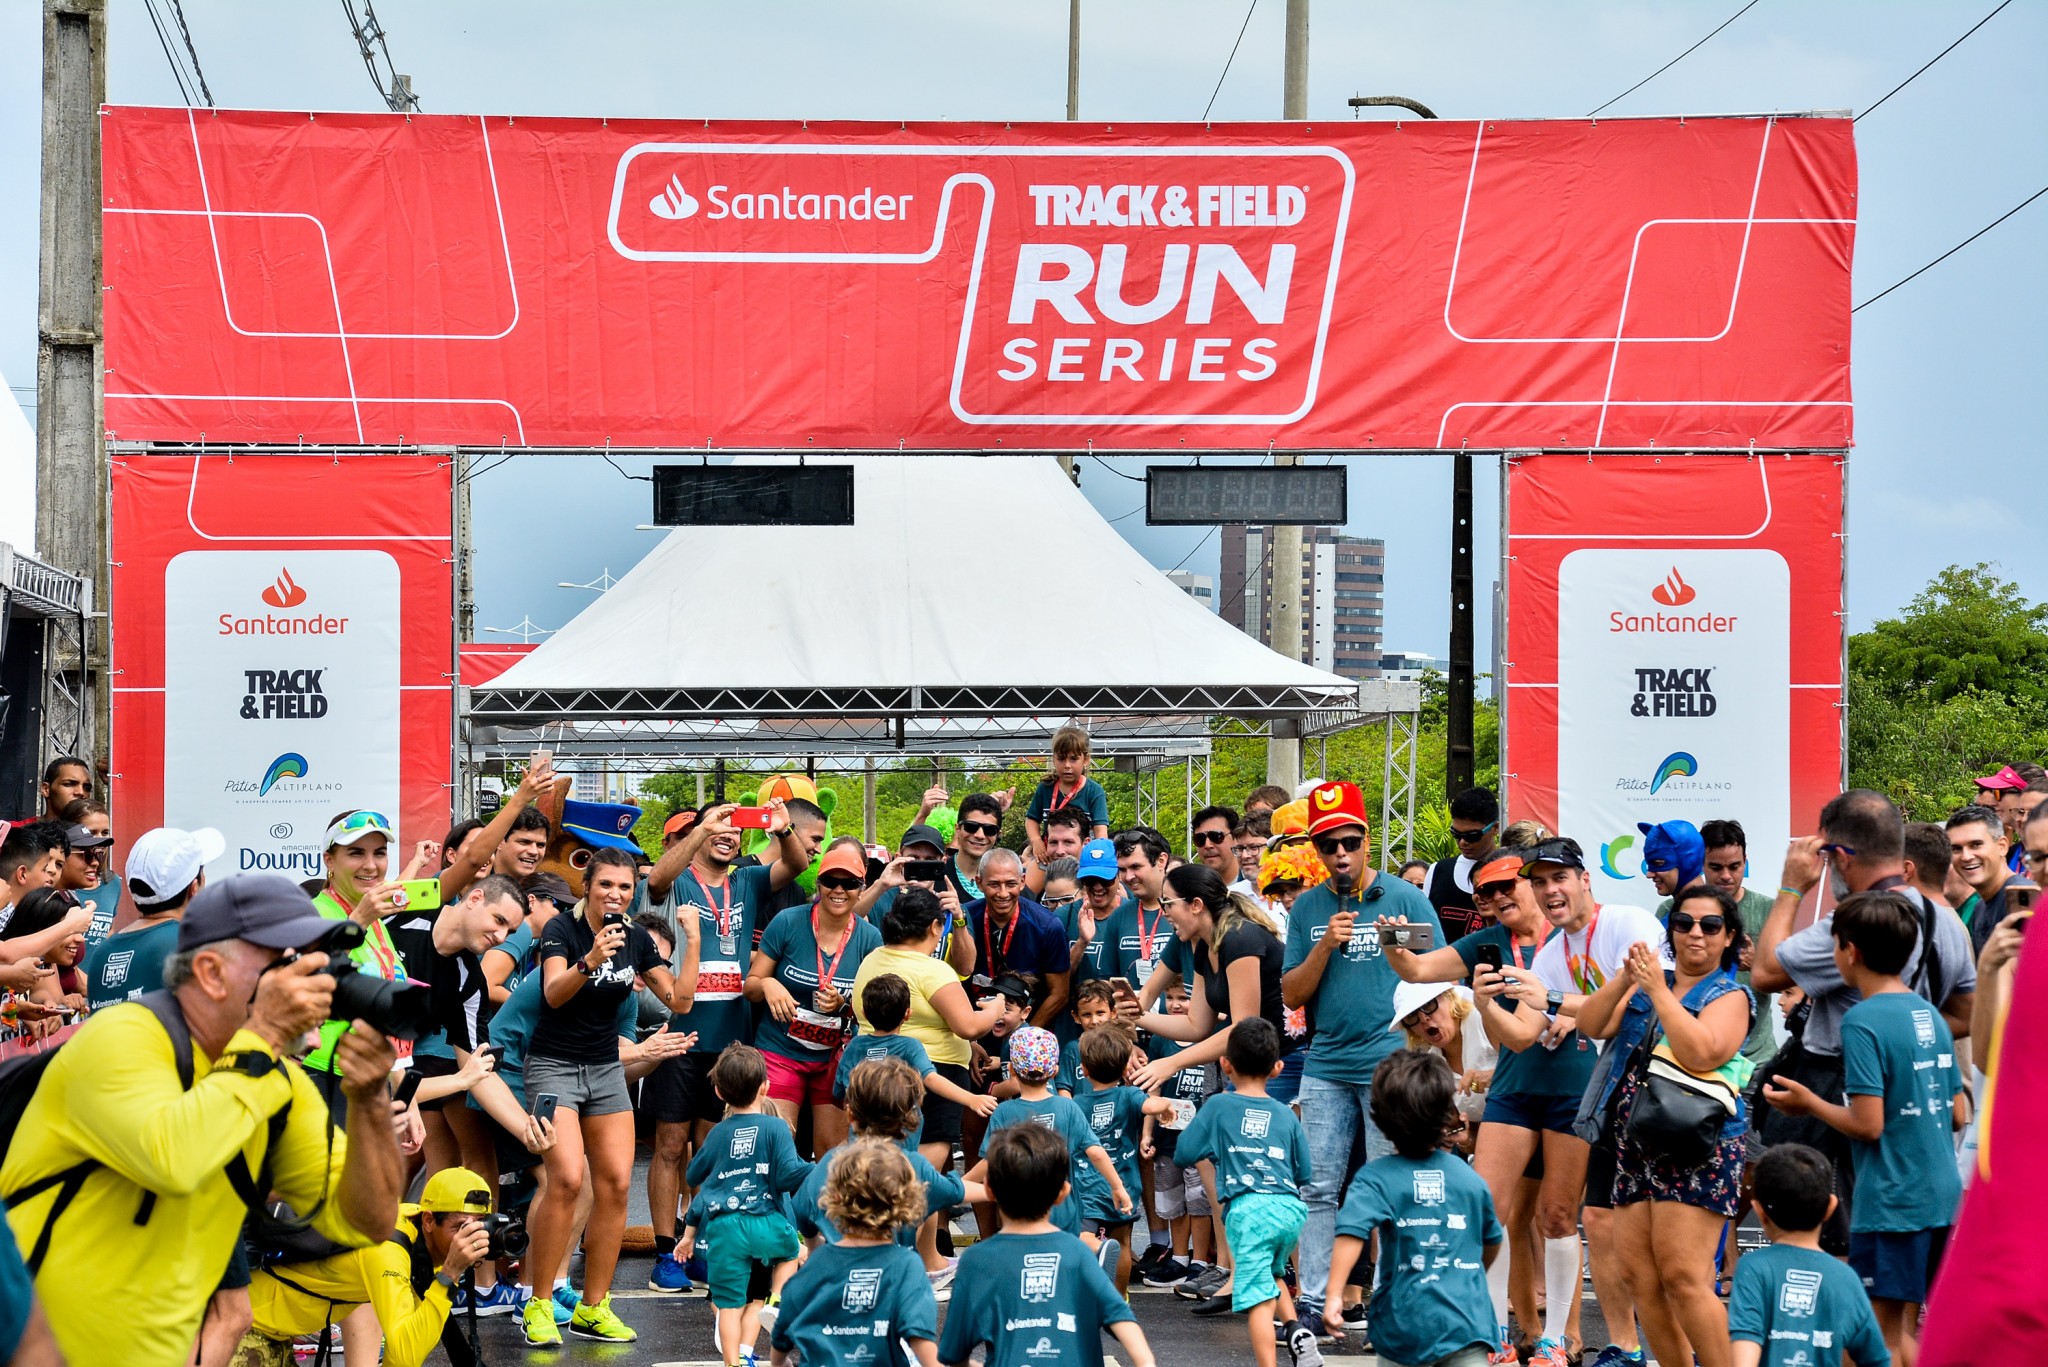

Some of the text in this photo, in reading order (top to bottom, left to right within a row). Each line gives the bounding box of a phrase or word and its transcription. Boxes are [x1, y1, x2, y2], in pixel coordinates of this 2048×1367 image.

[707, 186, 913, 221] Santander
[1029, 185, 1157, 227] TRACK
[1198, 185, 1306, 227] FIELD
[1006, 243, 1297, 325] RUN
[997, 337, 1278, 382] SERIES
[219, 614, 348, 635] Santander
[1610, 612, 1737, 633] Santander
[244, 669, 323, 694] TRACK
[1634, 668, 1712, 692] TRACK
[240, 695, 328, 719] & FIELD
[1630, 693, 1717, 717] & FIELD
[224, 780, 343, 793] Pátio ALTIPLANO
[1615, 778, 1732, 790] Pátio ALTIPLANO
[240, 848, 321, 876] Downy
[1347, 945, 1377, 953] SERIES
[1348, 934, 1379, 946] RUN
[107, 969, 126, 977] RUN
[791, 1021, 838, 1043] 2666
[725, 1167, 751, 1178] Santander
[1026, 1277, 1053, 1287] RUN
[846, 1290, 874, 1300] RUN
[832, 1326, 870, 1336] Santander
[1013, 1317, 1052, 1329] Santander
